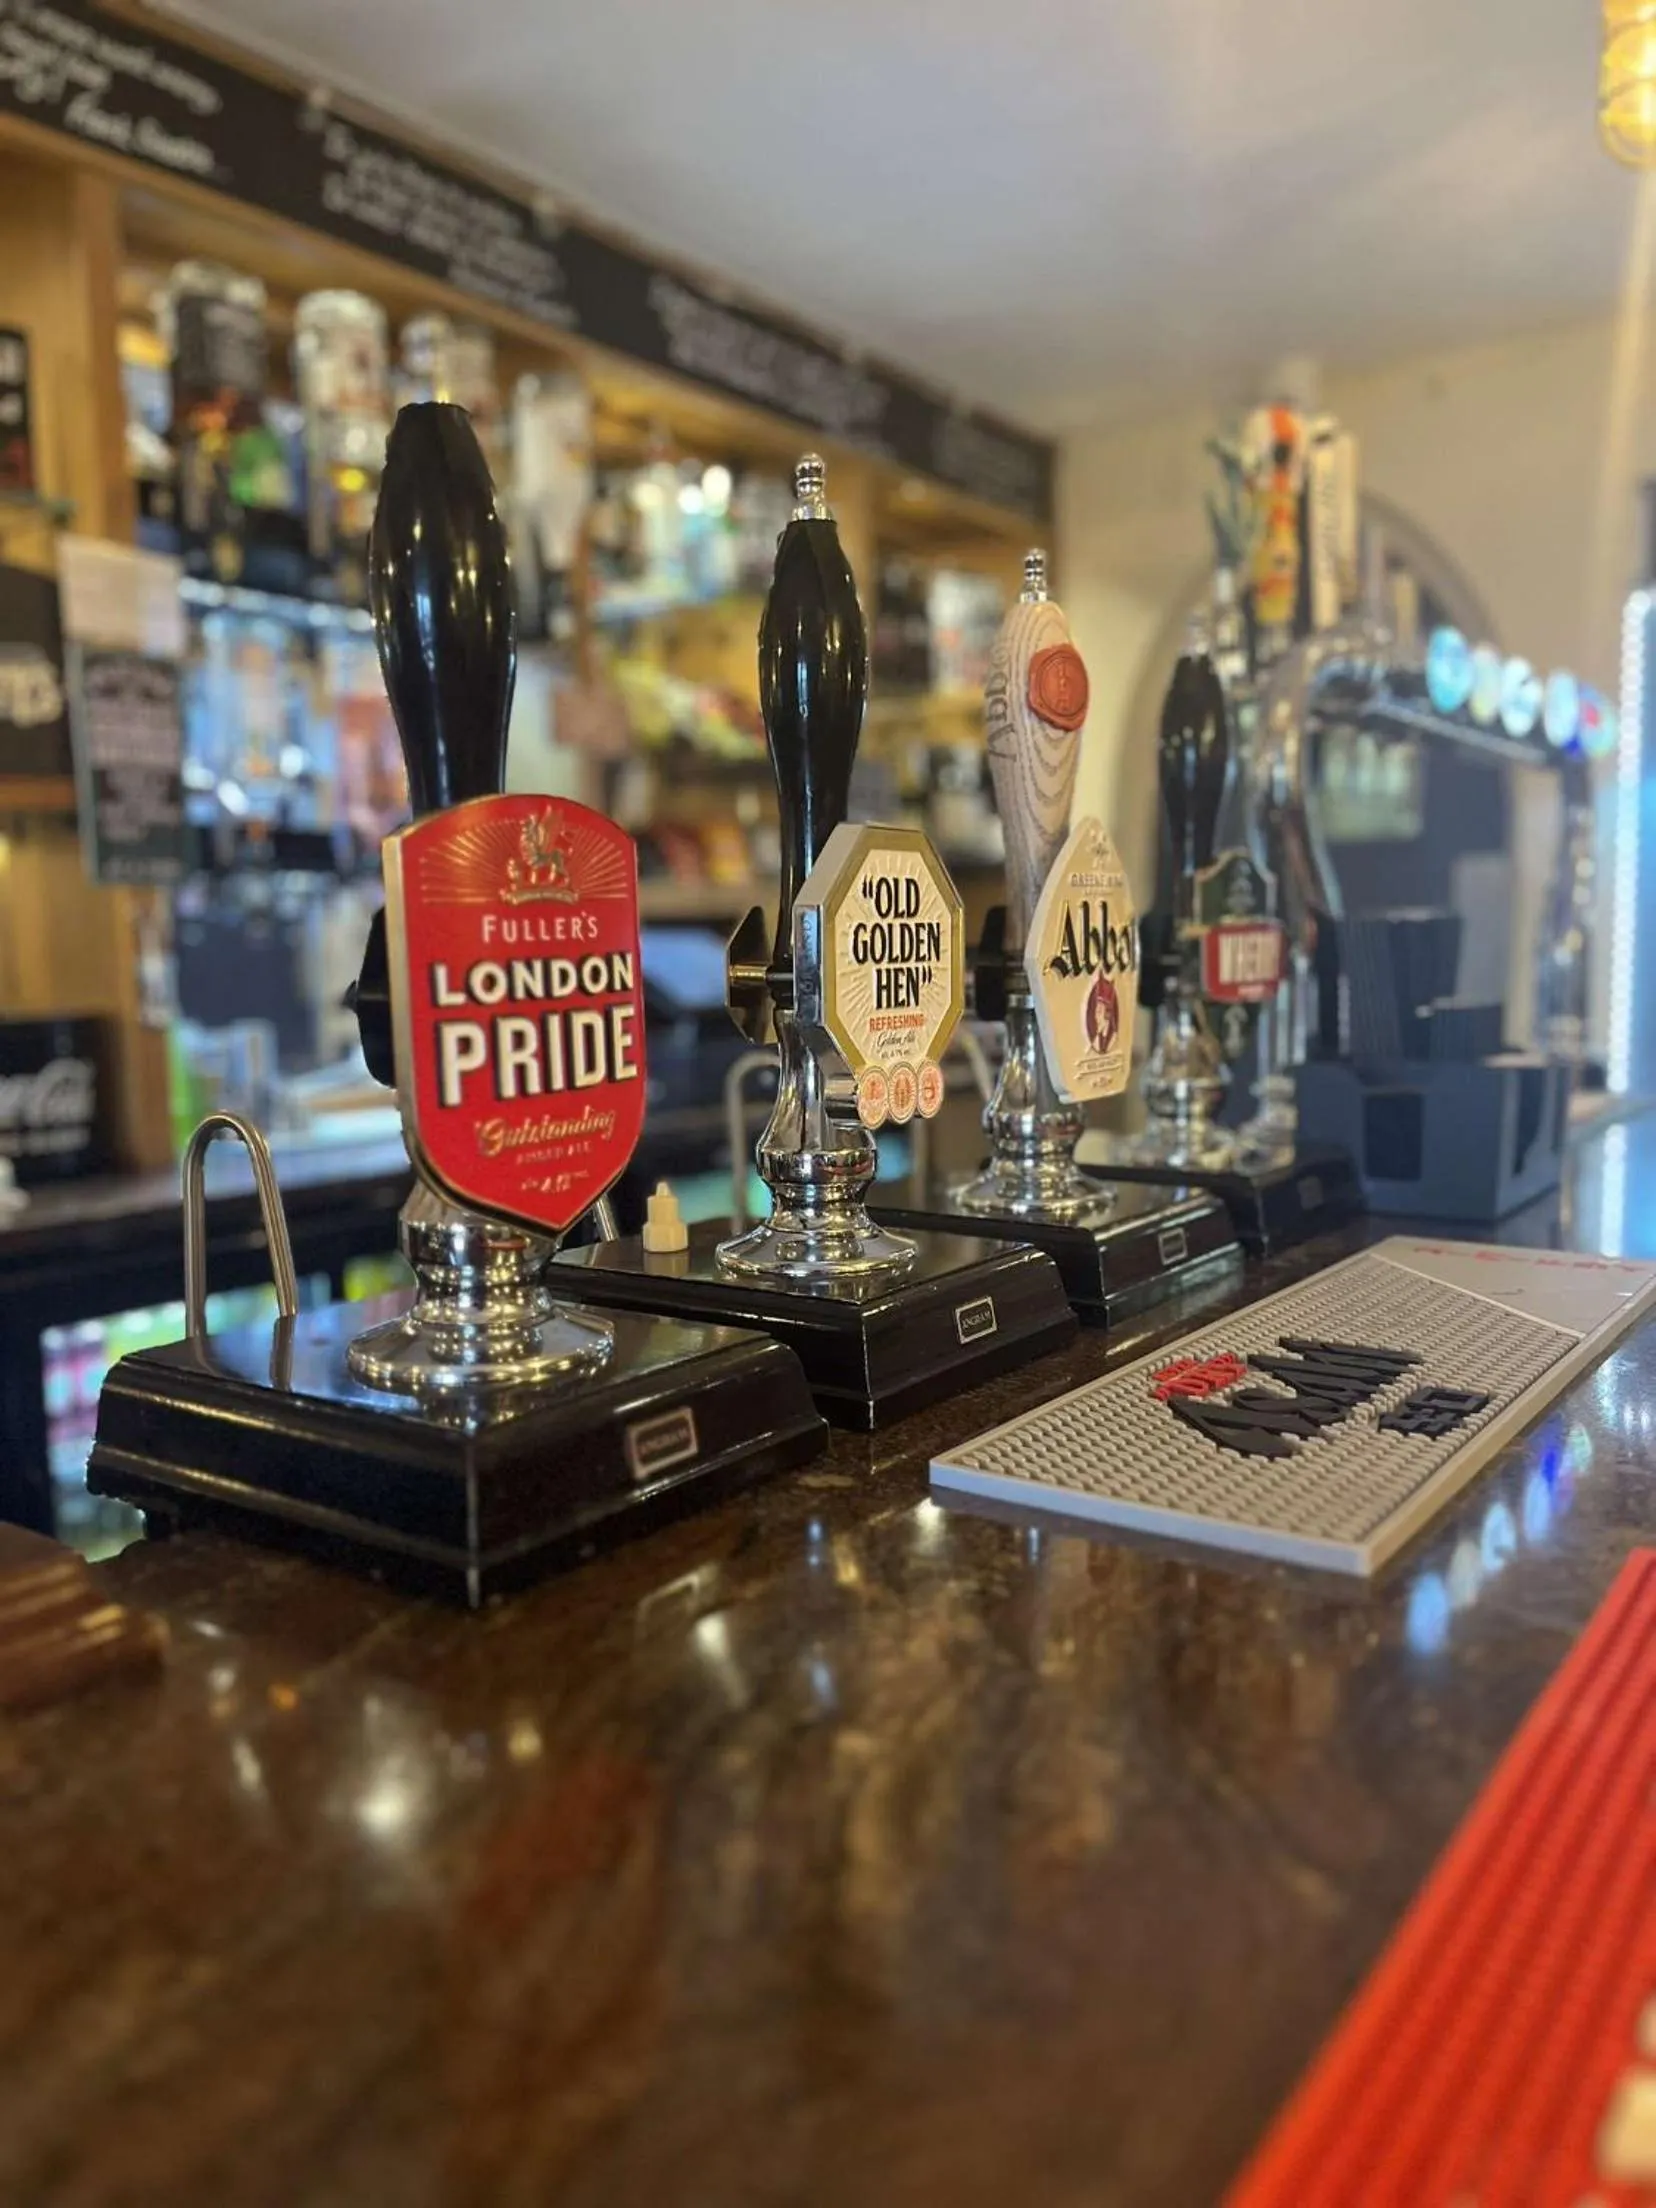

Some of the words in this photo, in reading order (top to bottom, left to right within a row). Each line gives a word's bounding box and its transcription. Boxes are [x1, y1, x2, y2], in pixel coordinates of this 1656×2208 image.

[482, 911, 599, 943] FULLER'S
[852, 921, 941, 964] GOLDEN
[432, 952, 634, 1006] LONDON
[869, 1013, 924, 1032] REFRESHING
[438, 1004, 638, 1108] PRIDE
[476, 1104, 616, 1156] Outstanding
